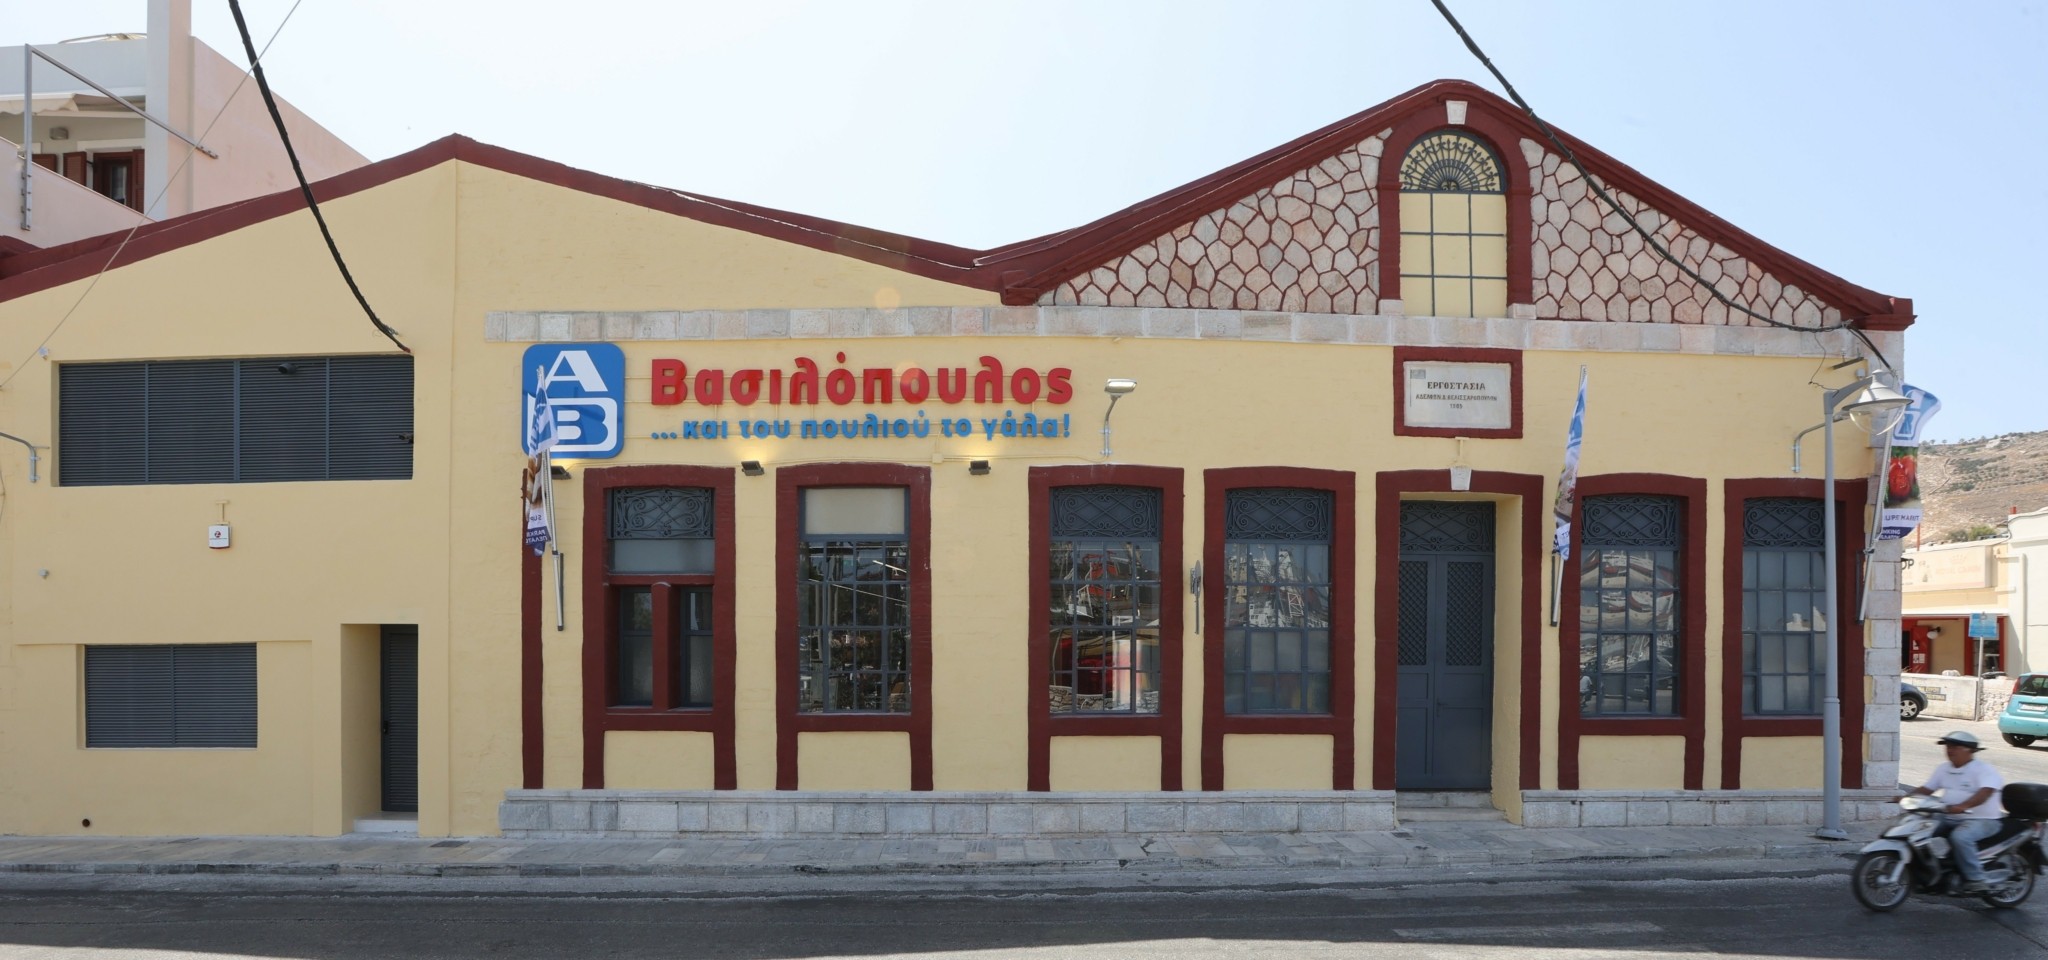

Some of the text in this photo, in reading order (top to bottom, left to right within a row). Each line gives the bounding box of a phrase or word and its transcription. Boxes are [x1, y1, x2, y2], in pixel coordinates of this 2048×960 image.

[651, 351, 1074, 407] Βασιλόπουλος
[1428, 382, 1486, 390] ΕΡΓΟΣΤΑΣΙΑ
[739, 420, 791, 440] του
[801, 409, 930, 440] πουλιού
[941, 418, 972, 439] το
[981, 409, 1071, 441] γάλα!
